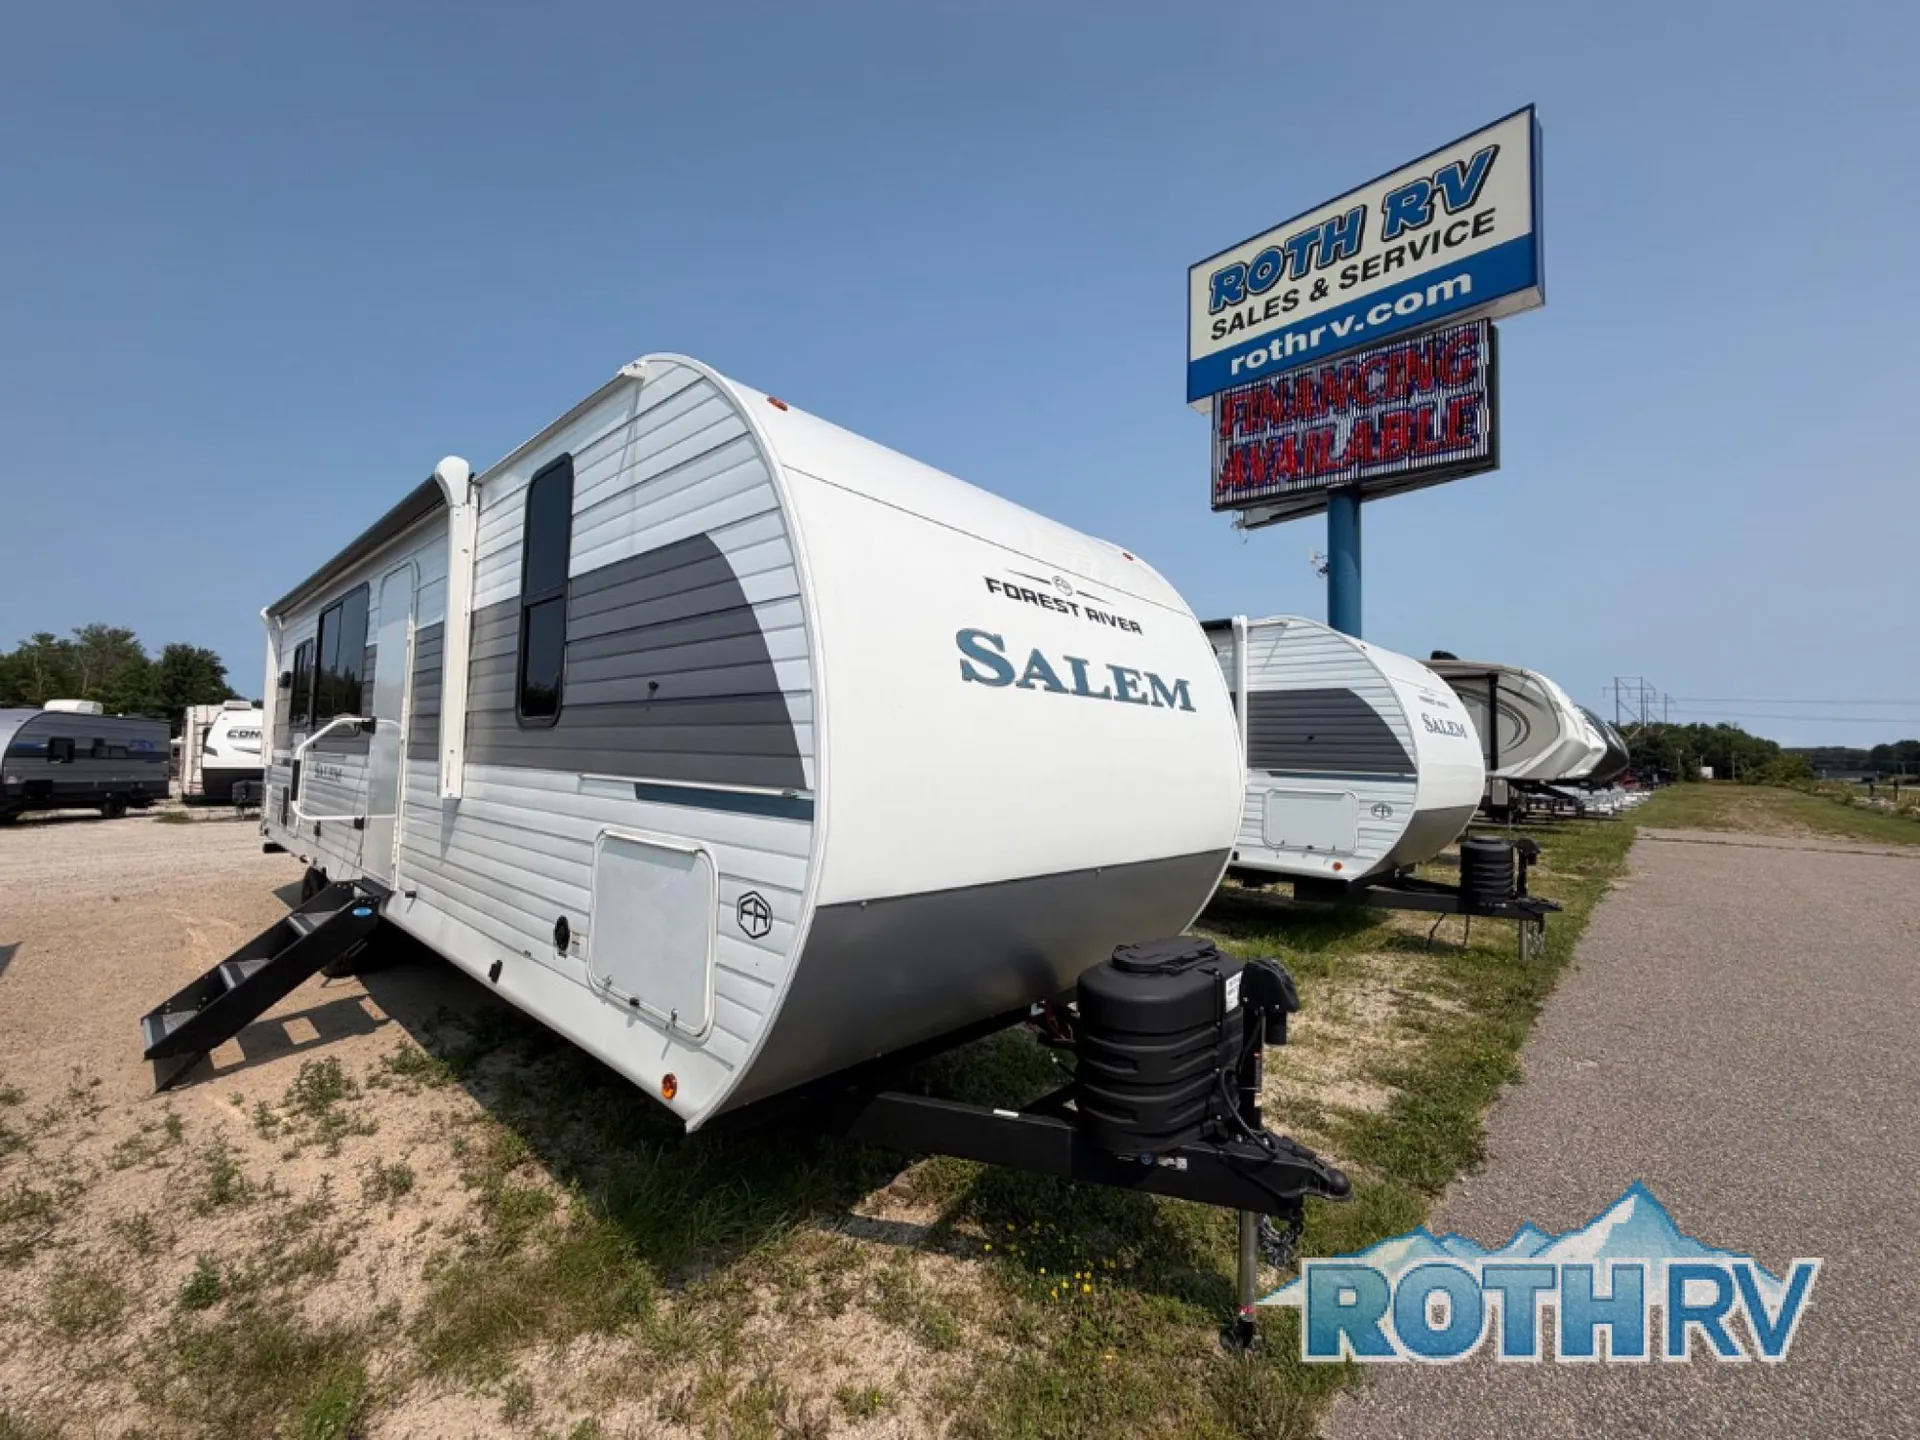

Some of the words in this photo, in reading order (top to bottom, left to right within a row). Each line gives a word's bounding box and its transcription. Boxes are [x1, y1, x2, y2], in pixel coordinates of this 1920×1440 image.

[1208, 204, 1367, 315] ROTH
[1380, 143, 1500, 242] RV
[1211, 288, 1300, 341] SALES
[1309, 277, 1329, 302] &
[1338, 207, 1496, 290] SERVICE
[1230, 273, 1472, 376] rothrv.com
[1219, 330, 1476, 439] FINANCING
[1217, 395, 1479, 491] AVAILABLE
[983, 576, 1079, 617] FOREST
[1084, 606, 1143, 635] RIVER
[955, 627, 1196, 712] SALEM
[1420, 712, 1468, 740] SALEM
